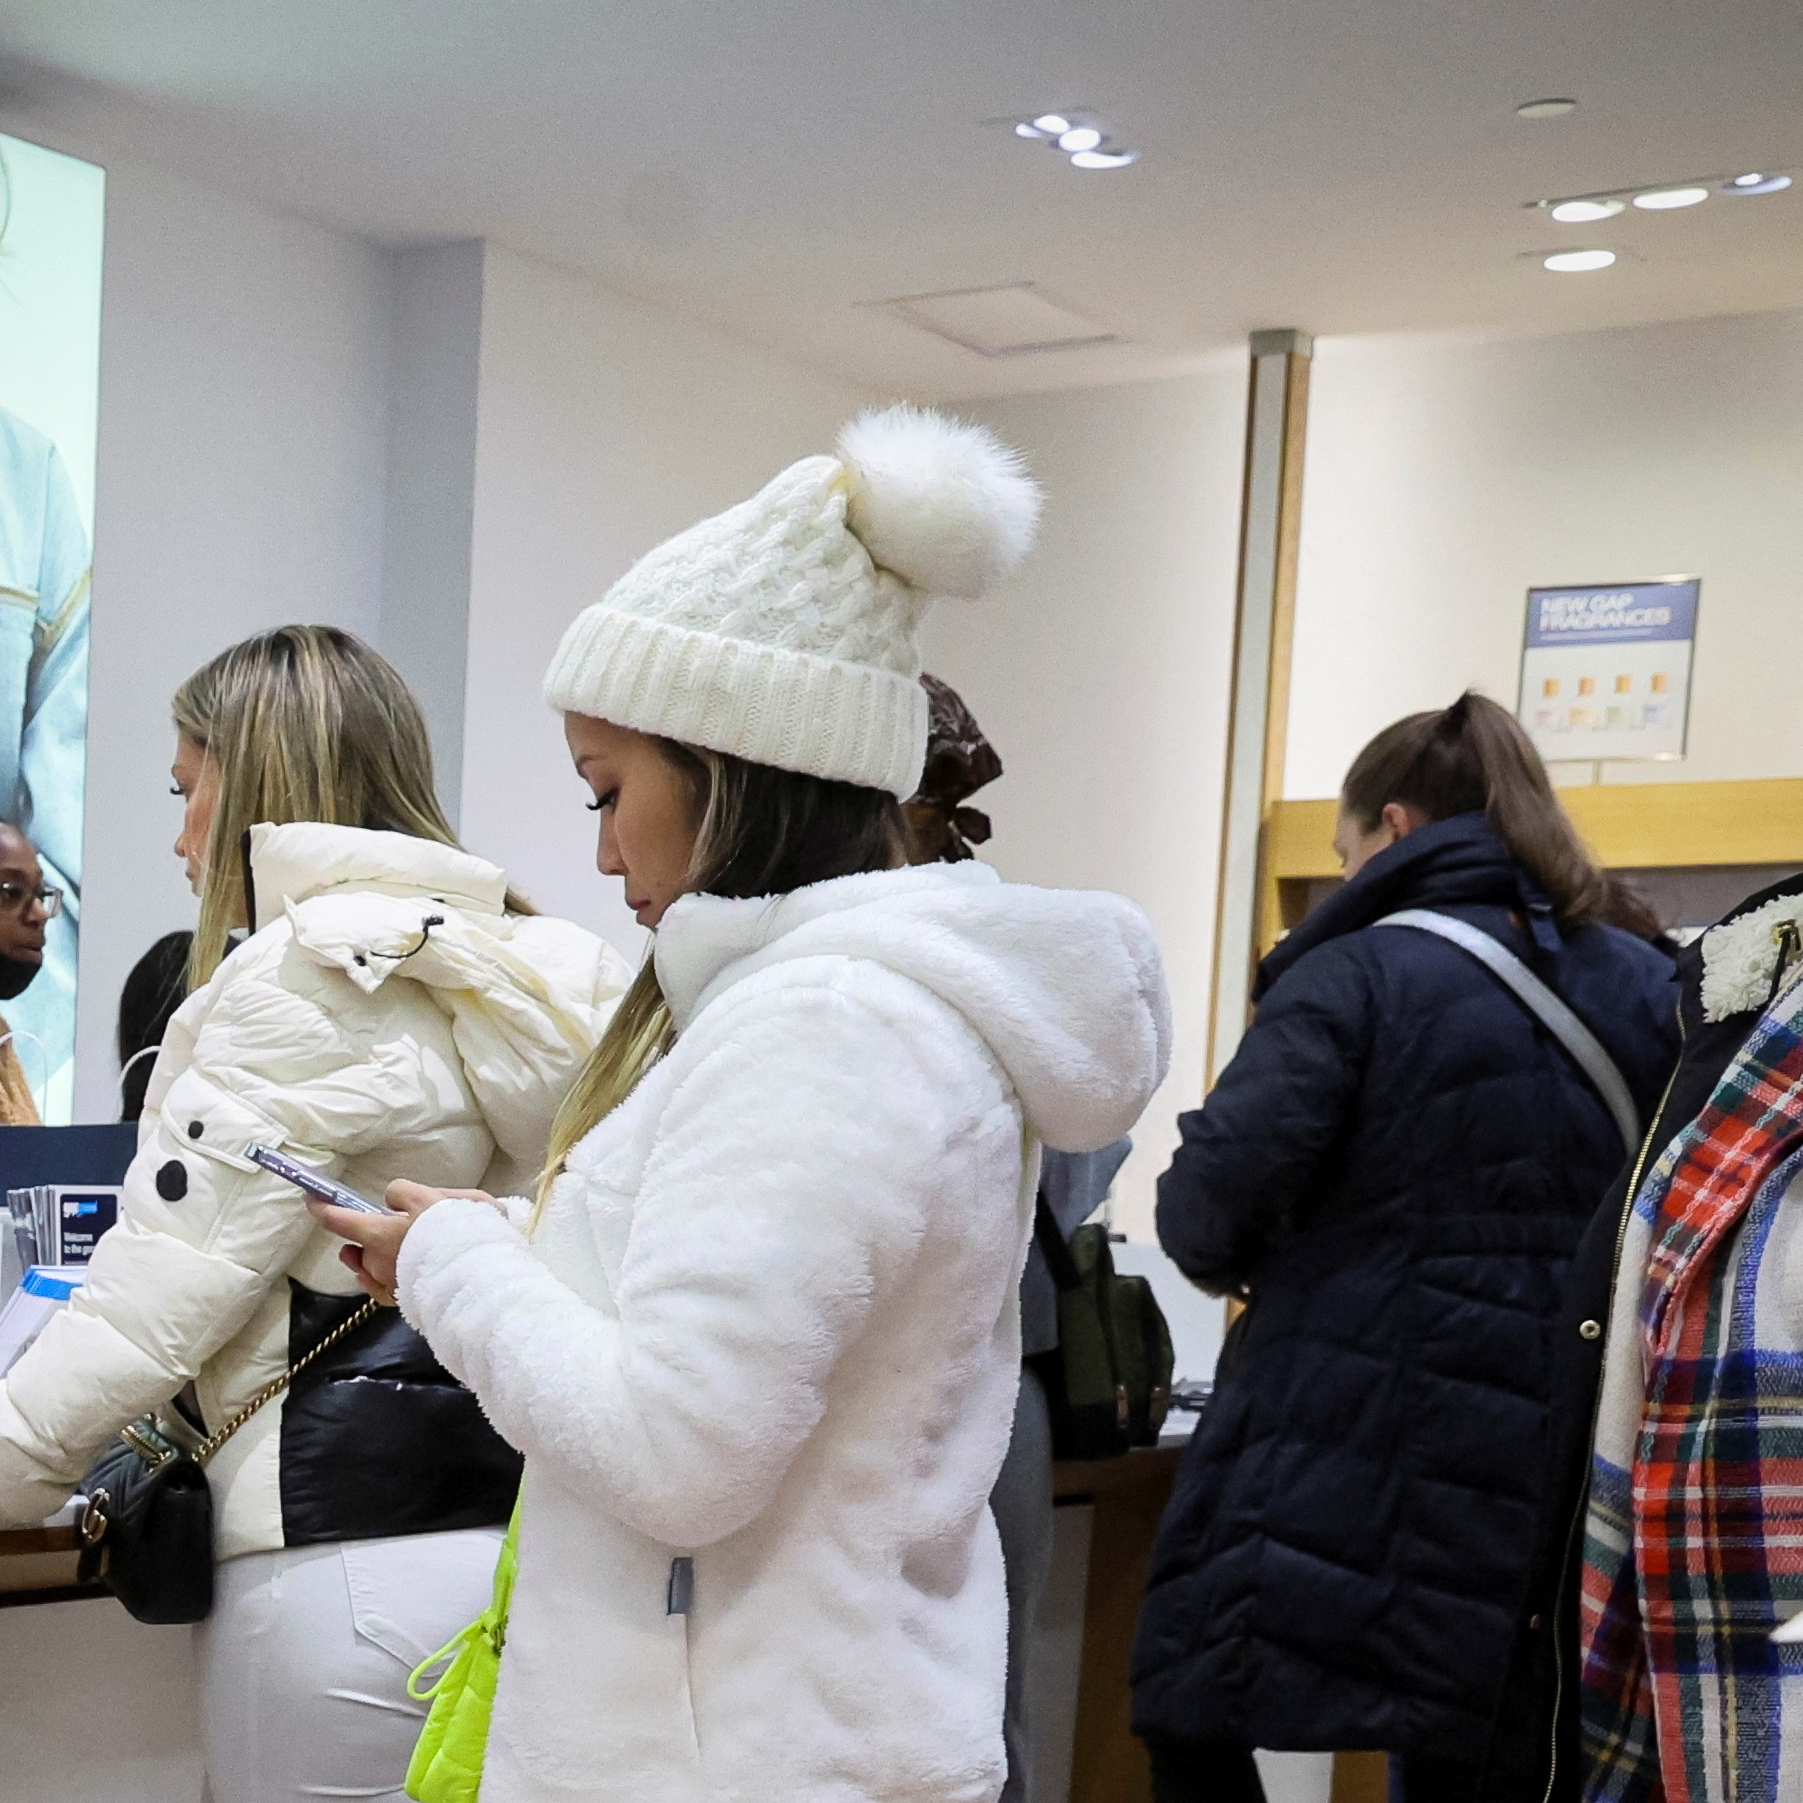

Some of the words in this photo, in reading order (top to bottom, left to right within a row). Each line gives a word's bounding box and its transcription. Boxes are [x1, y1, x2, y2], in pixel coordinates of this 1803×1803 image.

[1540, 596, 1589, 614] NEW
[1589, 592, 1635, 612] GAP
[1539, 606, 1672, 631] FRAGRANCES
